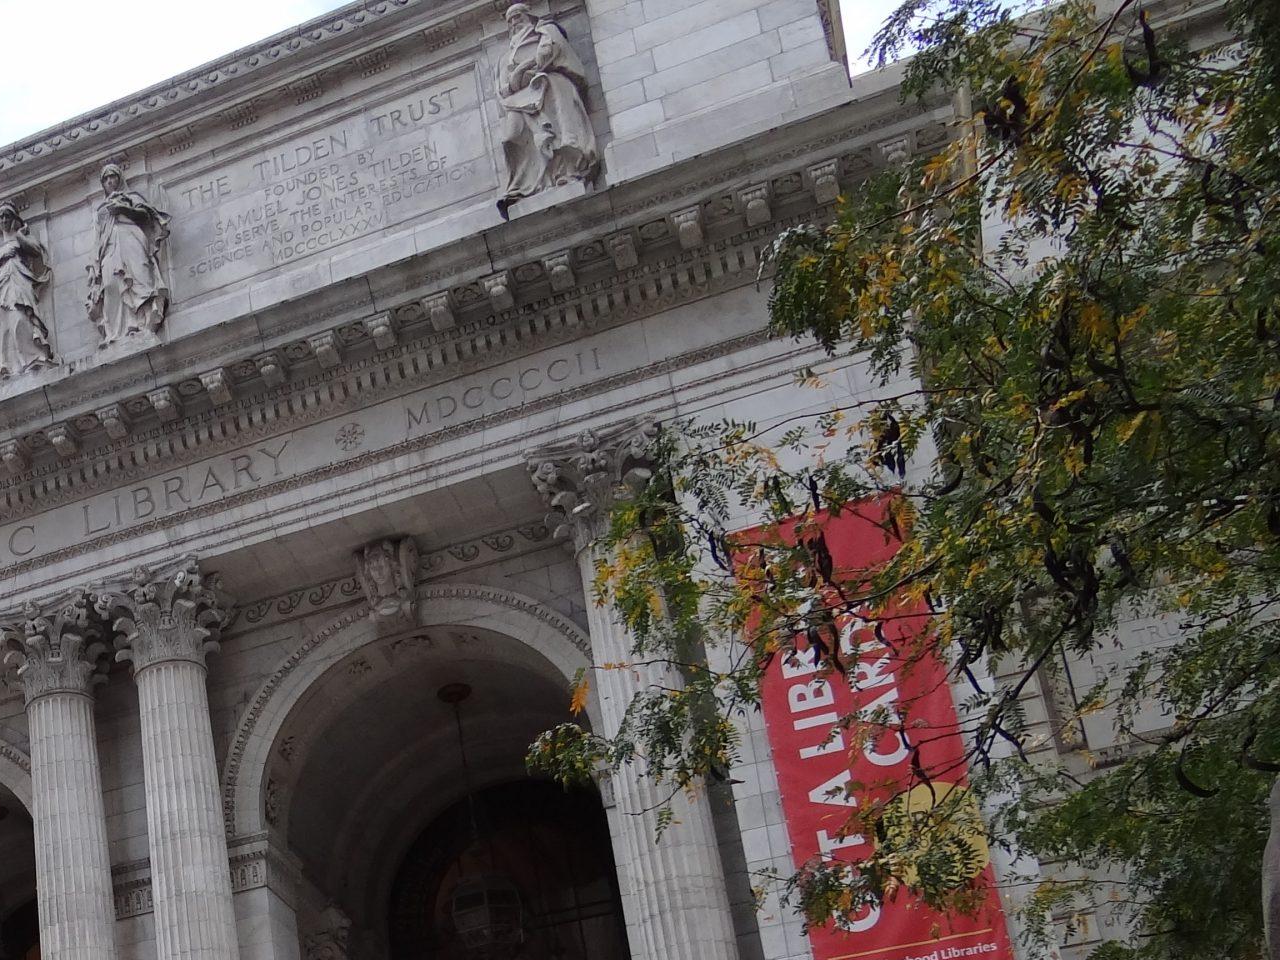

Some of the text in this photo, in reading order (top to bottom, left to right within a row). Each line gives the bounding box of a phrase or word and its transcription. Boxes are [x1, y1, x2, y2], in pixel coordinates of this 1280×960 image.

[181, 86, 459, 208] THE TILDEN TRUST
[215, 141, 438, 237] SAMUEL JONES TILDEN
[264, 148, 375, 199] FOUNDED BY
[188, 164, 477, 279] SCIENCE AND POPULAR EDUCATION
[205, 155, 448, 257] TO SERVE THE INTERESTS OF
[82, 440, 288, 537] LIBRARY
[406, 347, 602, 429] MDCCCCII
[839, 615, 910, 767] CARD
[941, 941, 998, 960] Libraries
